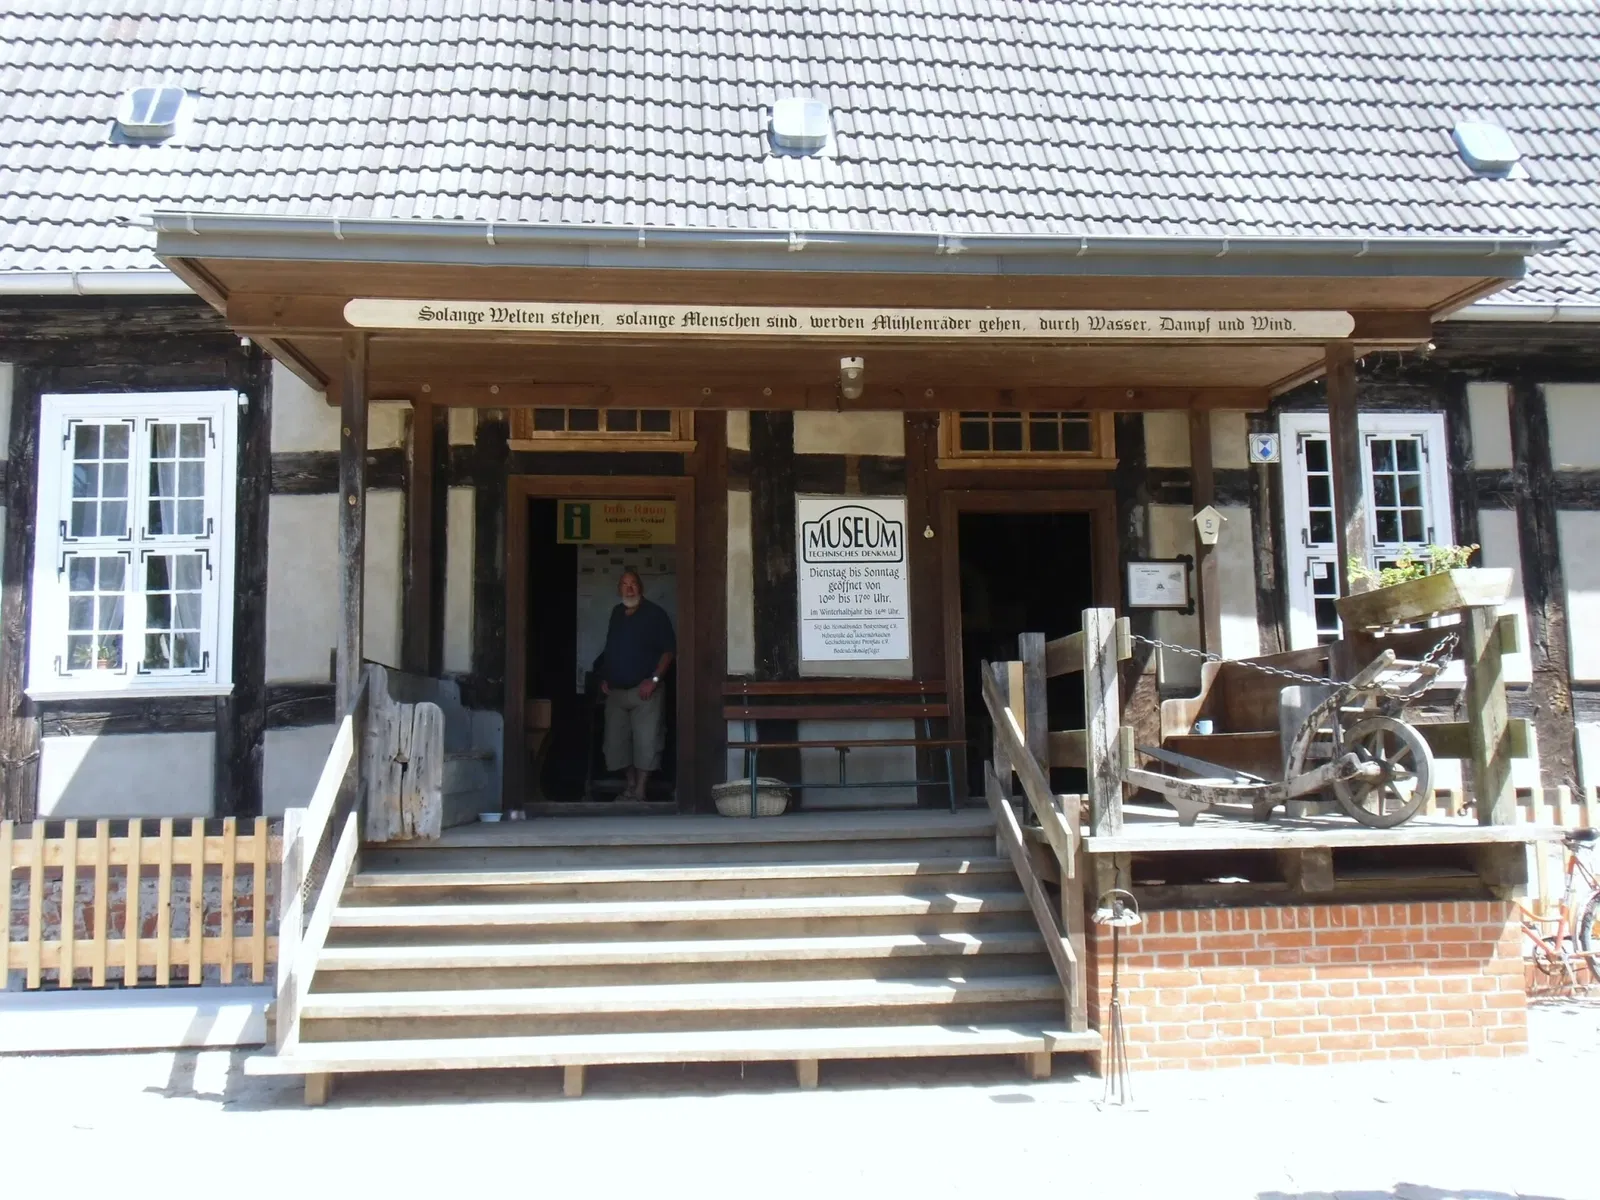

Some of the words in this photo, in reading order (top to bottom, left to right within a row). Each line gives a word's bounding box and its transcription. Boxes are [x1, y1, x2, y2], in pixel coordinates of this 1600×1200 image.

[417, 305, 485, 325] Solange
[489, 307, 545, 323] Welten
[551, 310, 605, 327] stehen,
[616, 310, 676, 328] solange
[681, 310, 760, 329] Menschen
[766, 313, 803, 329] sind,
[809, 314, 865, 328] werden
[871, 314, 972, 331] Mühlenräder
[978, 316, 1026, 333] gehen,
[1039, 316, 1079, 332] durch
[1159, 316, 1211, 333] Dampf
[1218, 317, 1245, 330] und
[1250, 315, 1296, 331] Wind.
[1205, 519, 1213, 529] 5
[809, 516, 897, 549] MUSEUM
[808, 550, 859, 558] TECHNISCHES
[809, 567, 847, 580] Dienstag
[849, 567, 861, 577] bis
[864, 567, 900, 579] Sonntag
[828, 579, 862, 593] geöffnet
[865, 581, 881, 590] von
[838, 593, 851, 603] bis
[873, 593, 892, 603] Uhr.
[810, 608, 818, 616] Im
[819, 608, 862, 617] Winterhalbjahr
[864, 608, 872, 616] bis
